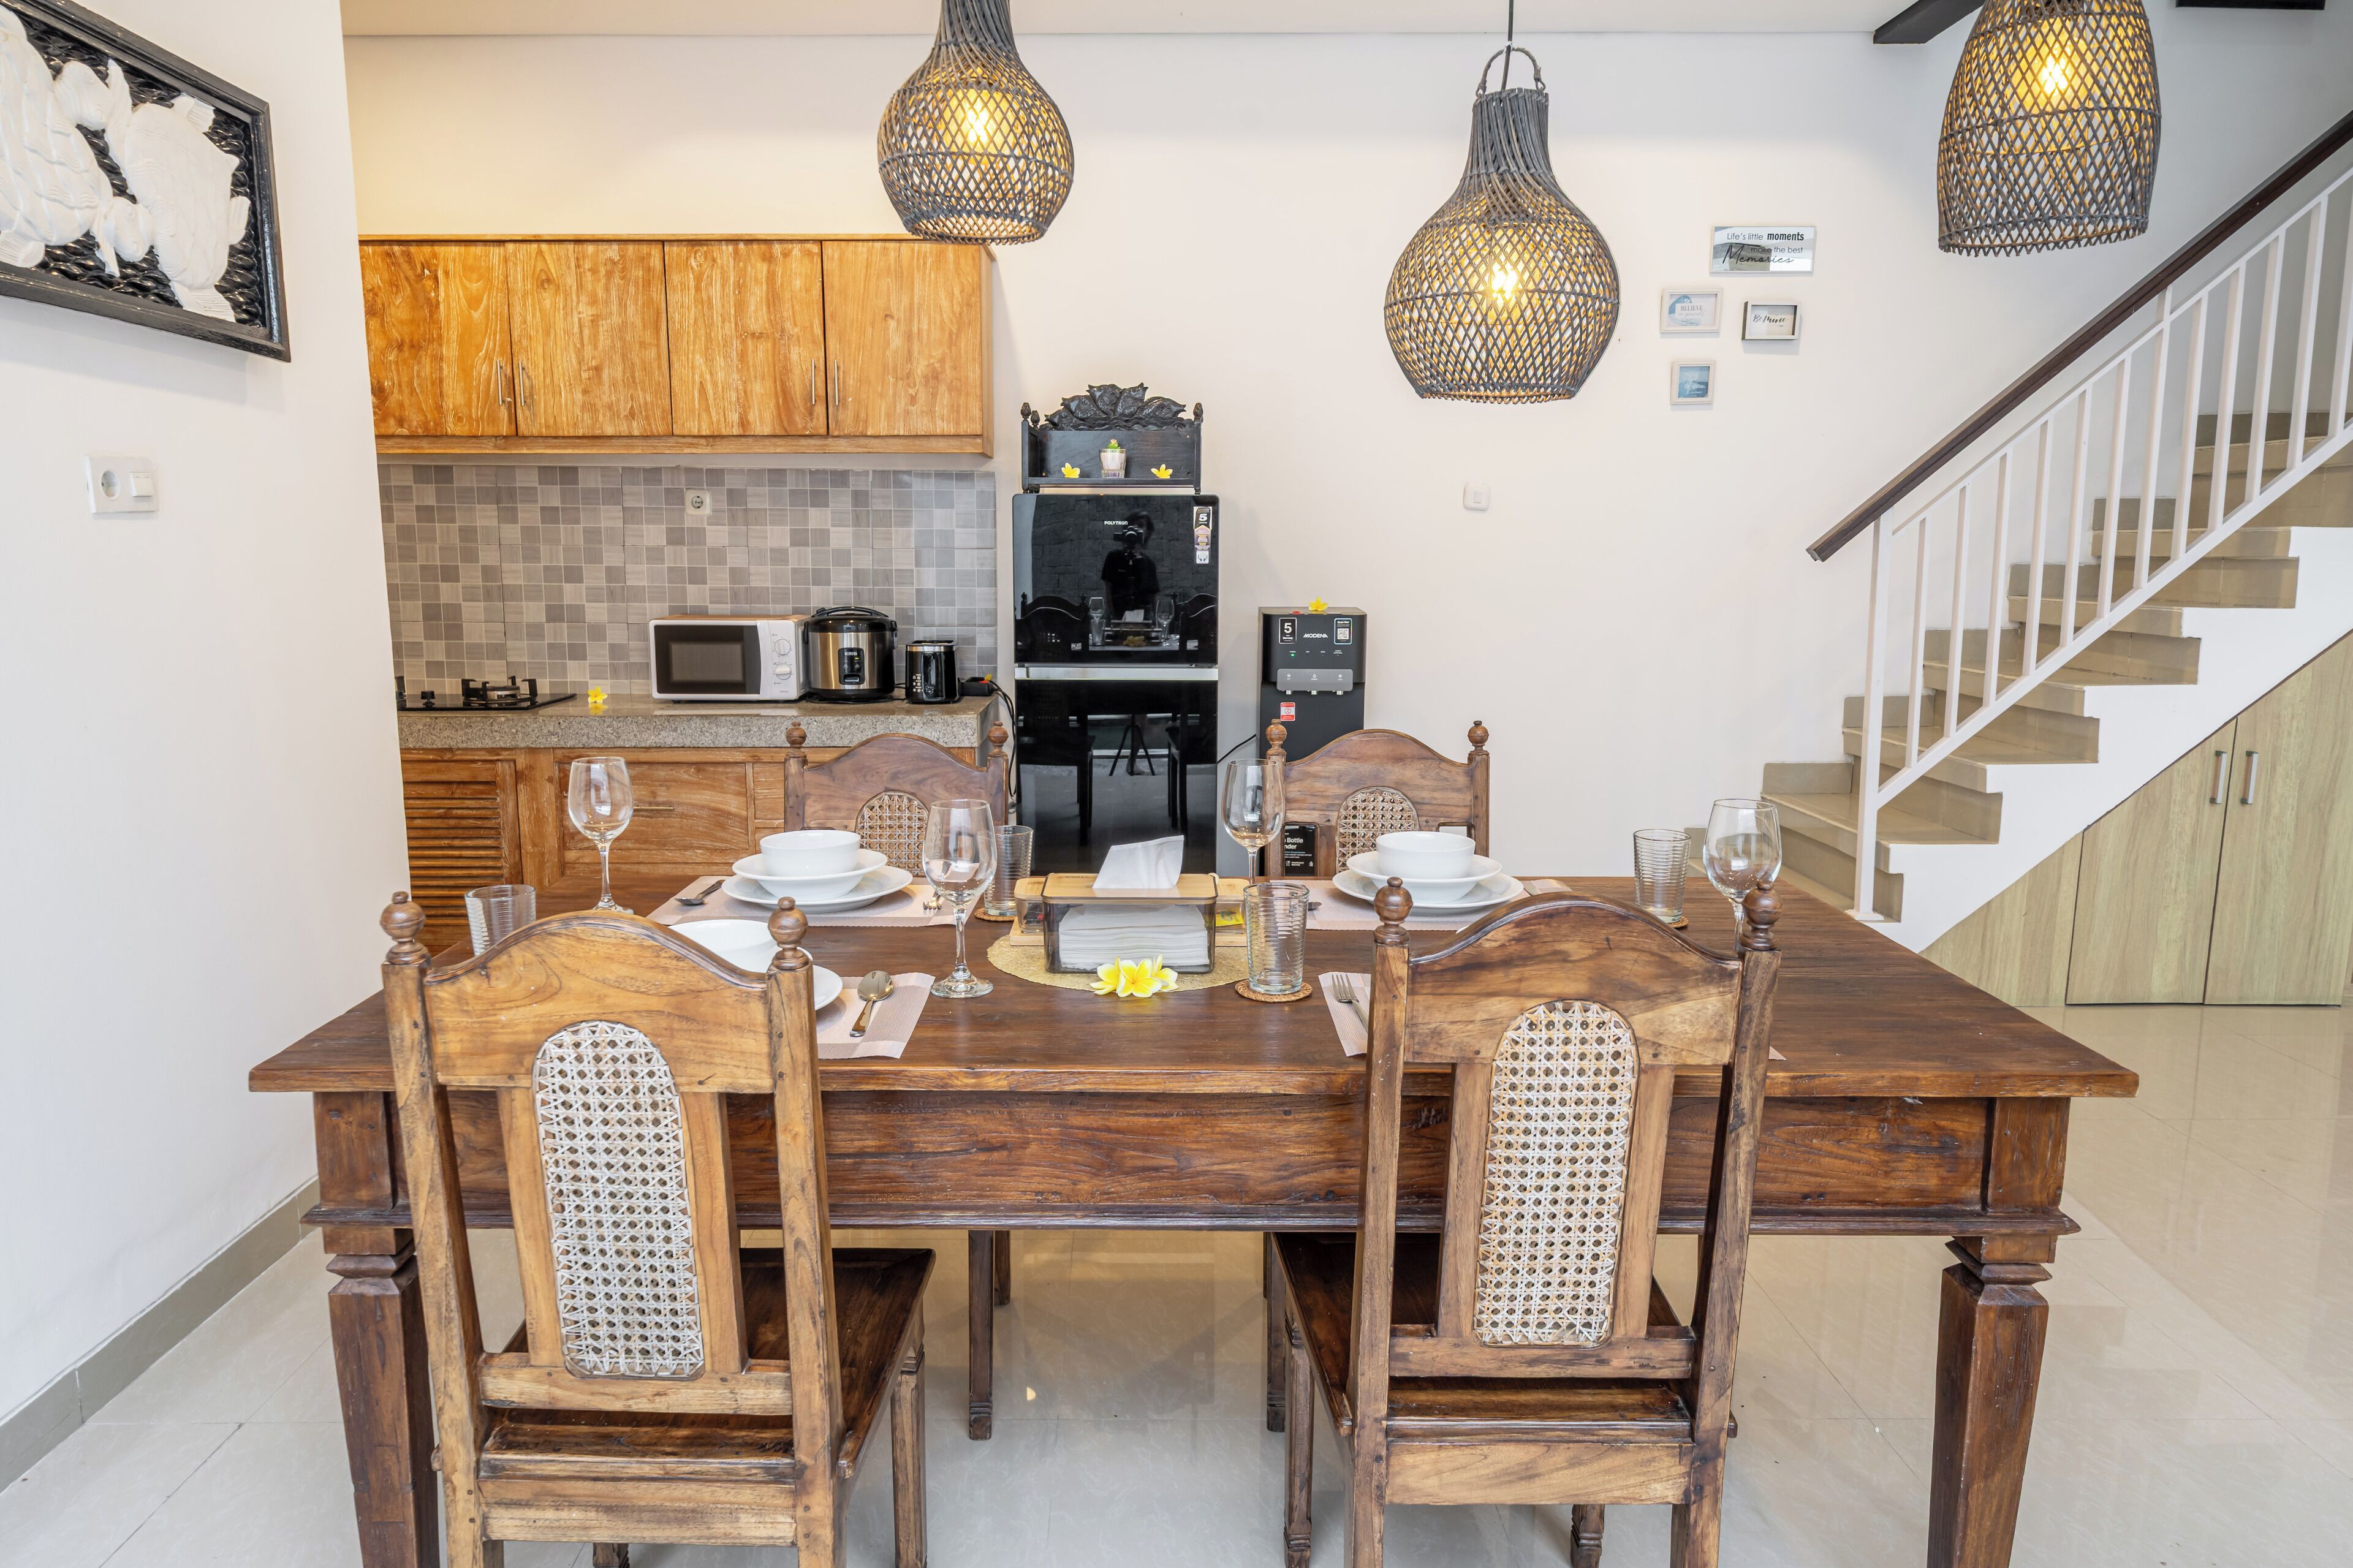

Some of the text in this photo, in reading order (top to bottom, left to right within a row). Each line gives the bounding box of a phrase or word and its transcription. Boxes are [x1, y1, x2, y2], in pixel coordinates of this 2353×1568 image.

[1767, 232, 1805, 241] moments
[1722, 244, 1794, 264] Memories
[1752, 314, 1762, 323] Be
[1199, 513, 1208, 521] 5
[1284, 623, 1292, 634] 5
